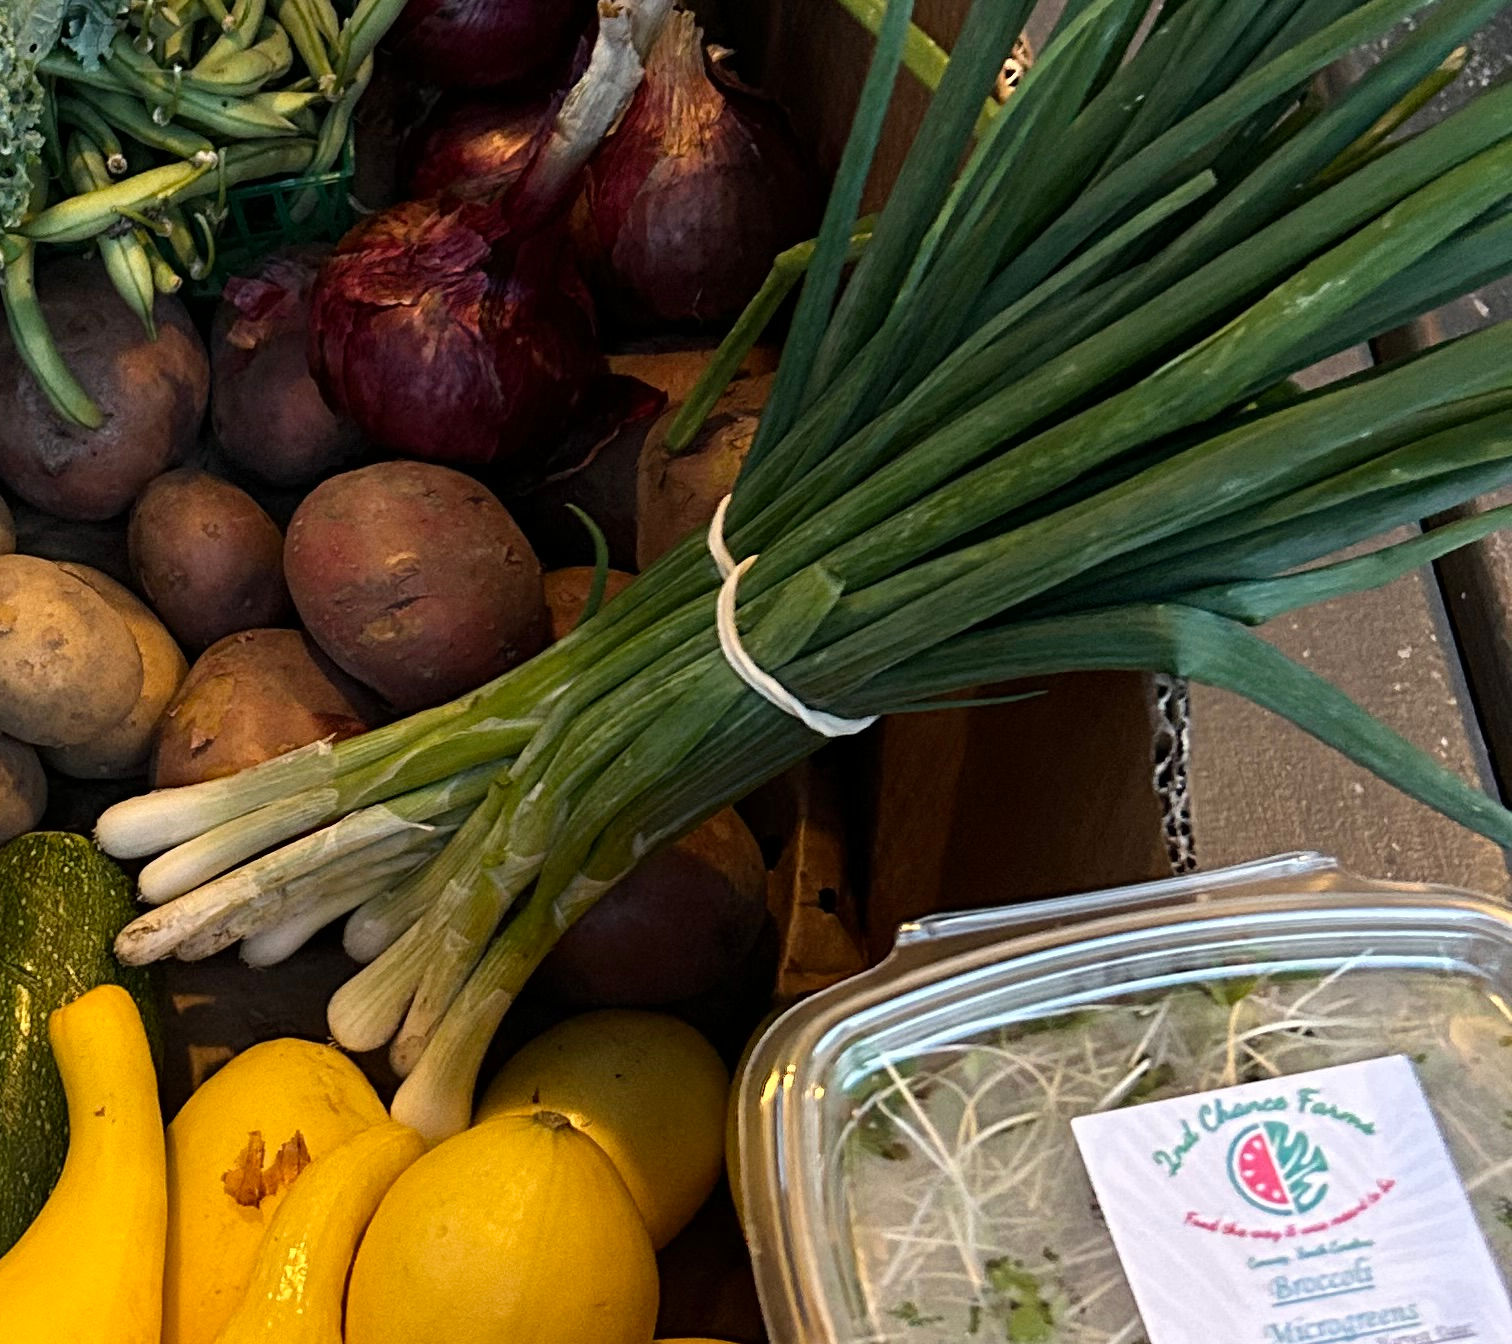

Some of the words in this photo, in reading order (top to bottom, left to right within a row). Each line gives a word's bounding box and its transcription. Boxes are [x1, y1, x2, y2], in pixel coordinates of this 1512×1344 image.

[1153, 1119, 1199, 1177] 2nd
[1199, 1098, 1288, 1133] Chance
[1298, 1087, 1376, 1135] Farms
[1270, 1258, 1374, 1300] Broccoli
